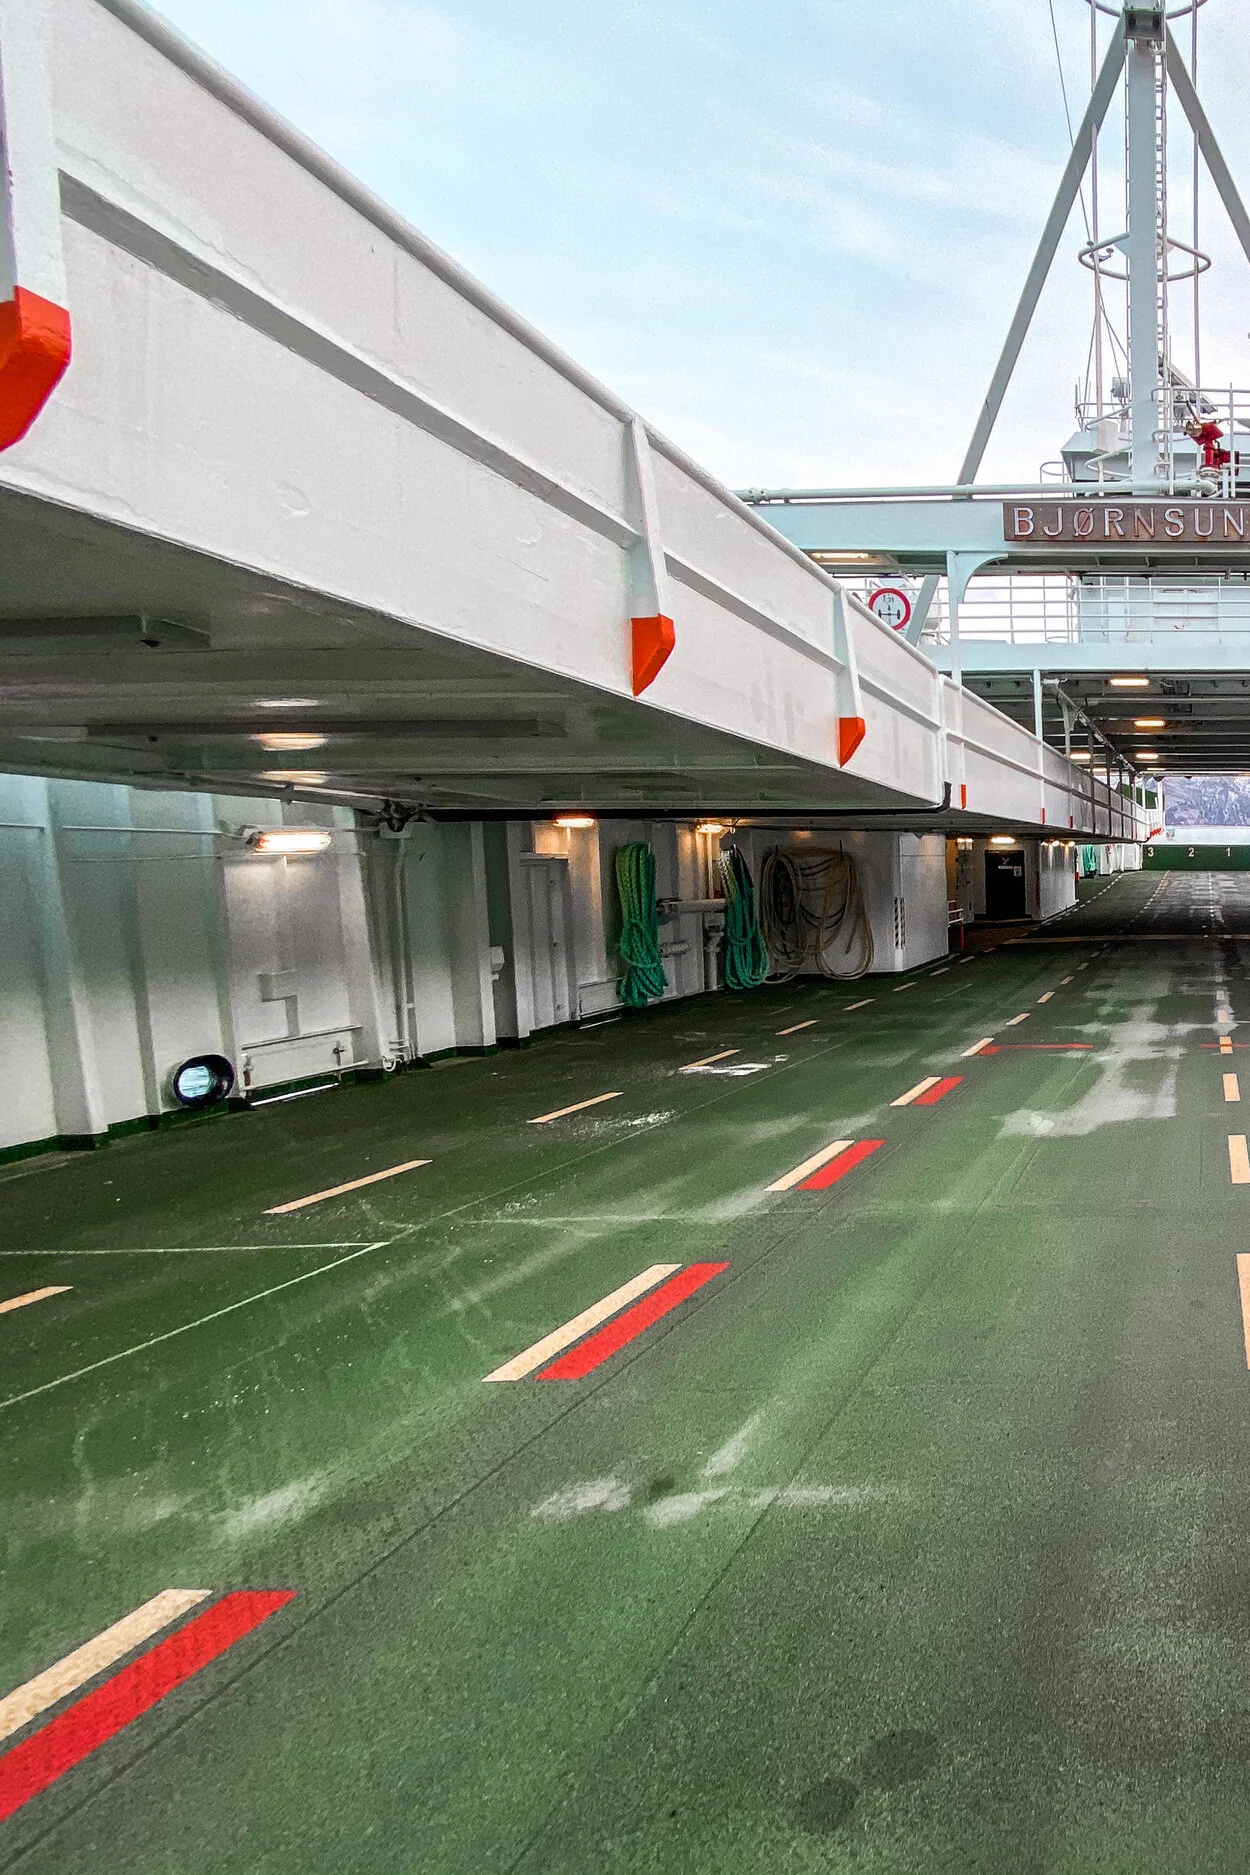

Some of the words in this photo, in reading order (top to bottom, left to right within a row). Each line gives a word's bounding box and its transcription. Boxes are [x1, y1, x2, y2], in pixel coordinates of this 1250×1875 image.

[1147, 847, 1154, 857] 3
[1188, 847, 1195, 857] 2
[1225, 847, 1231, 857] 1
